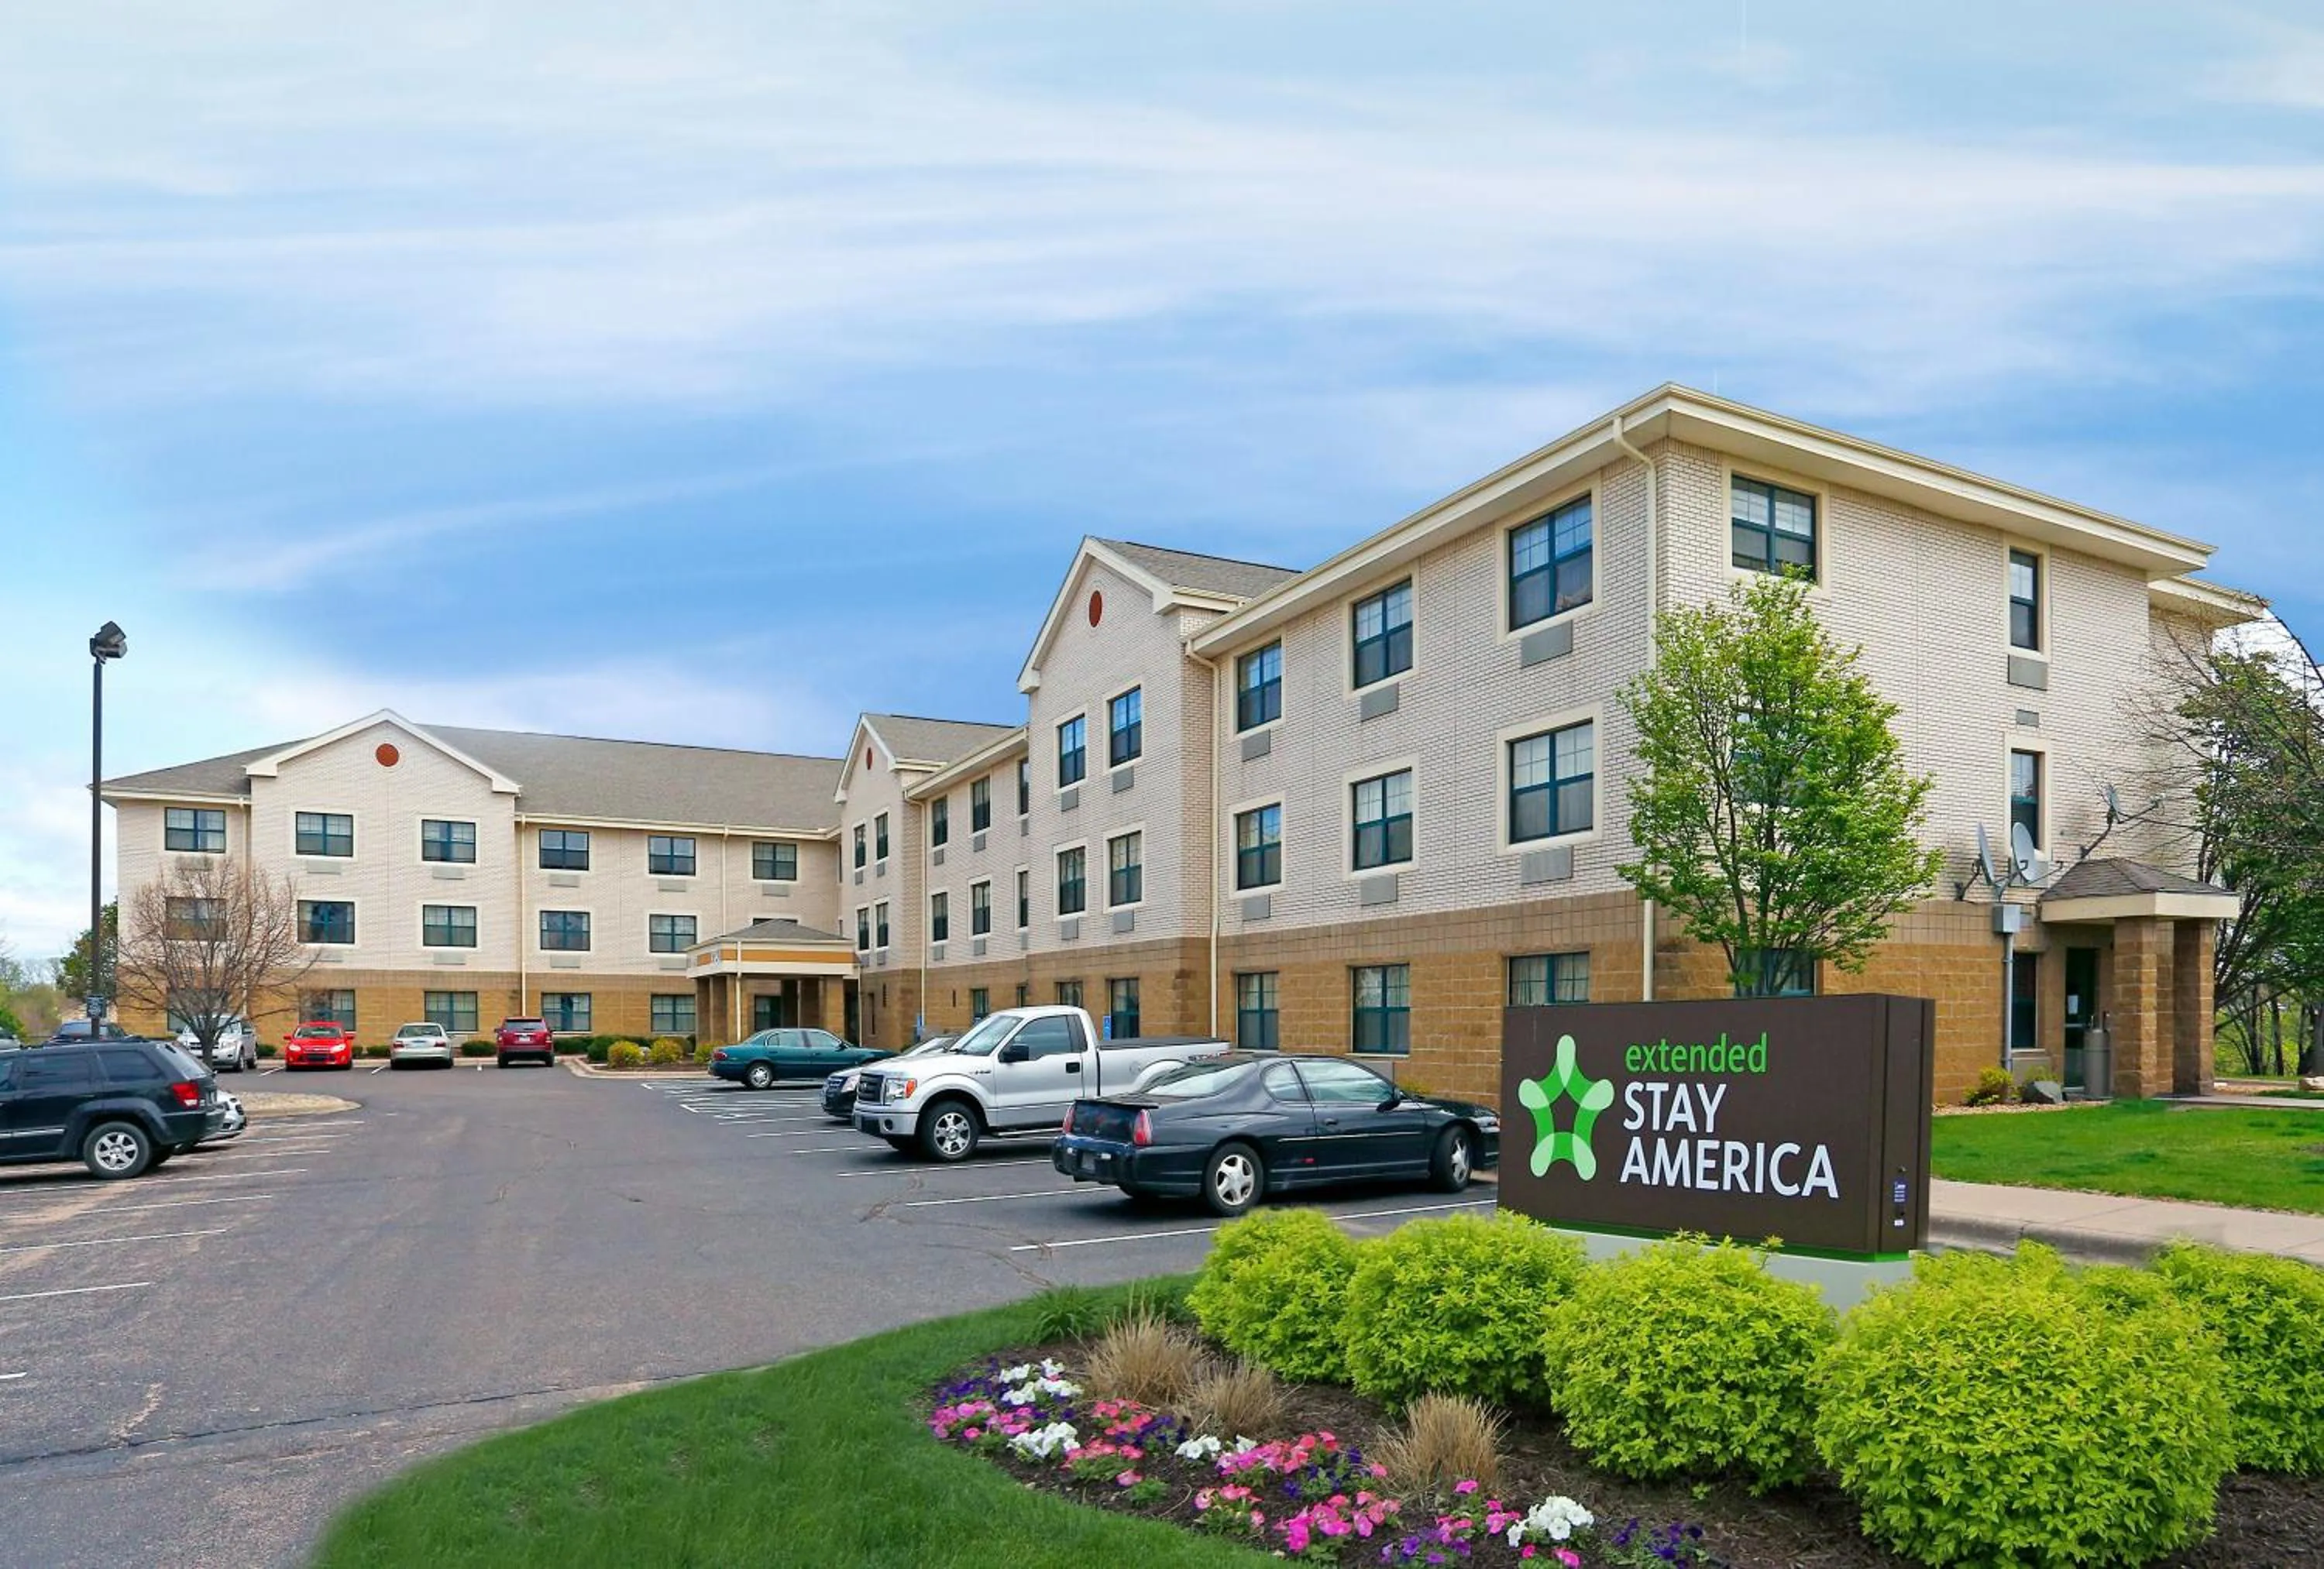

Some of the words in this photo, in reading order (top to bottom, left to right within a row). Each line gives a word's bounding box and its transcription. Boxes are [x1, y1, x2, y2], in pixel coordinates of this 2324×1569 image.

[1625, 1032, 1769, 1074] extended
[1622, 1081, 1727, 1133] STAY
[1620, 1136, 1839, 1199] AMERICA
